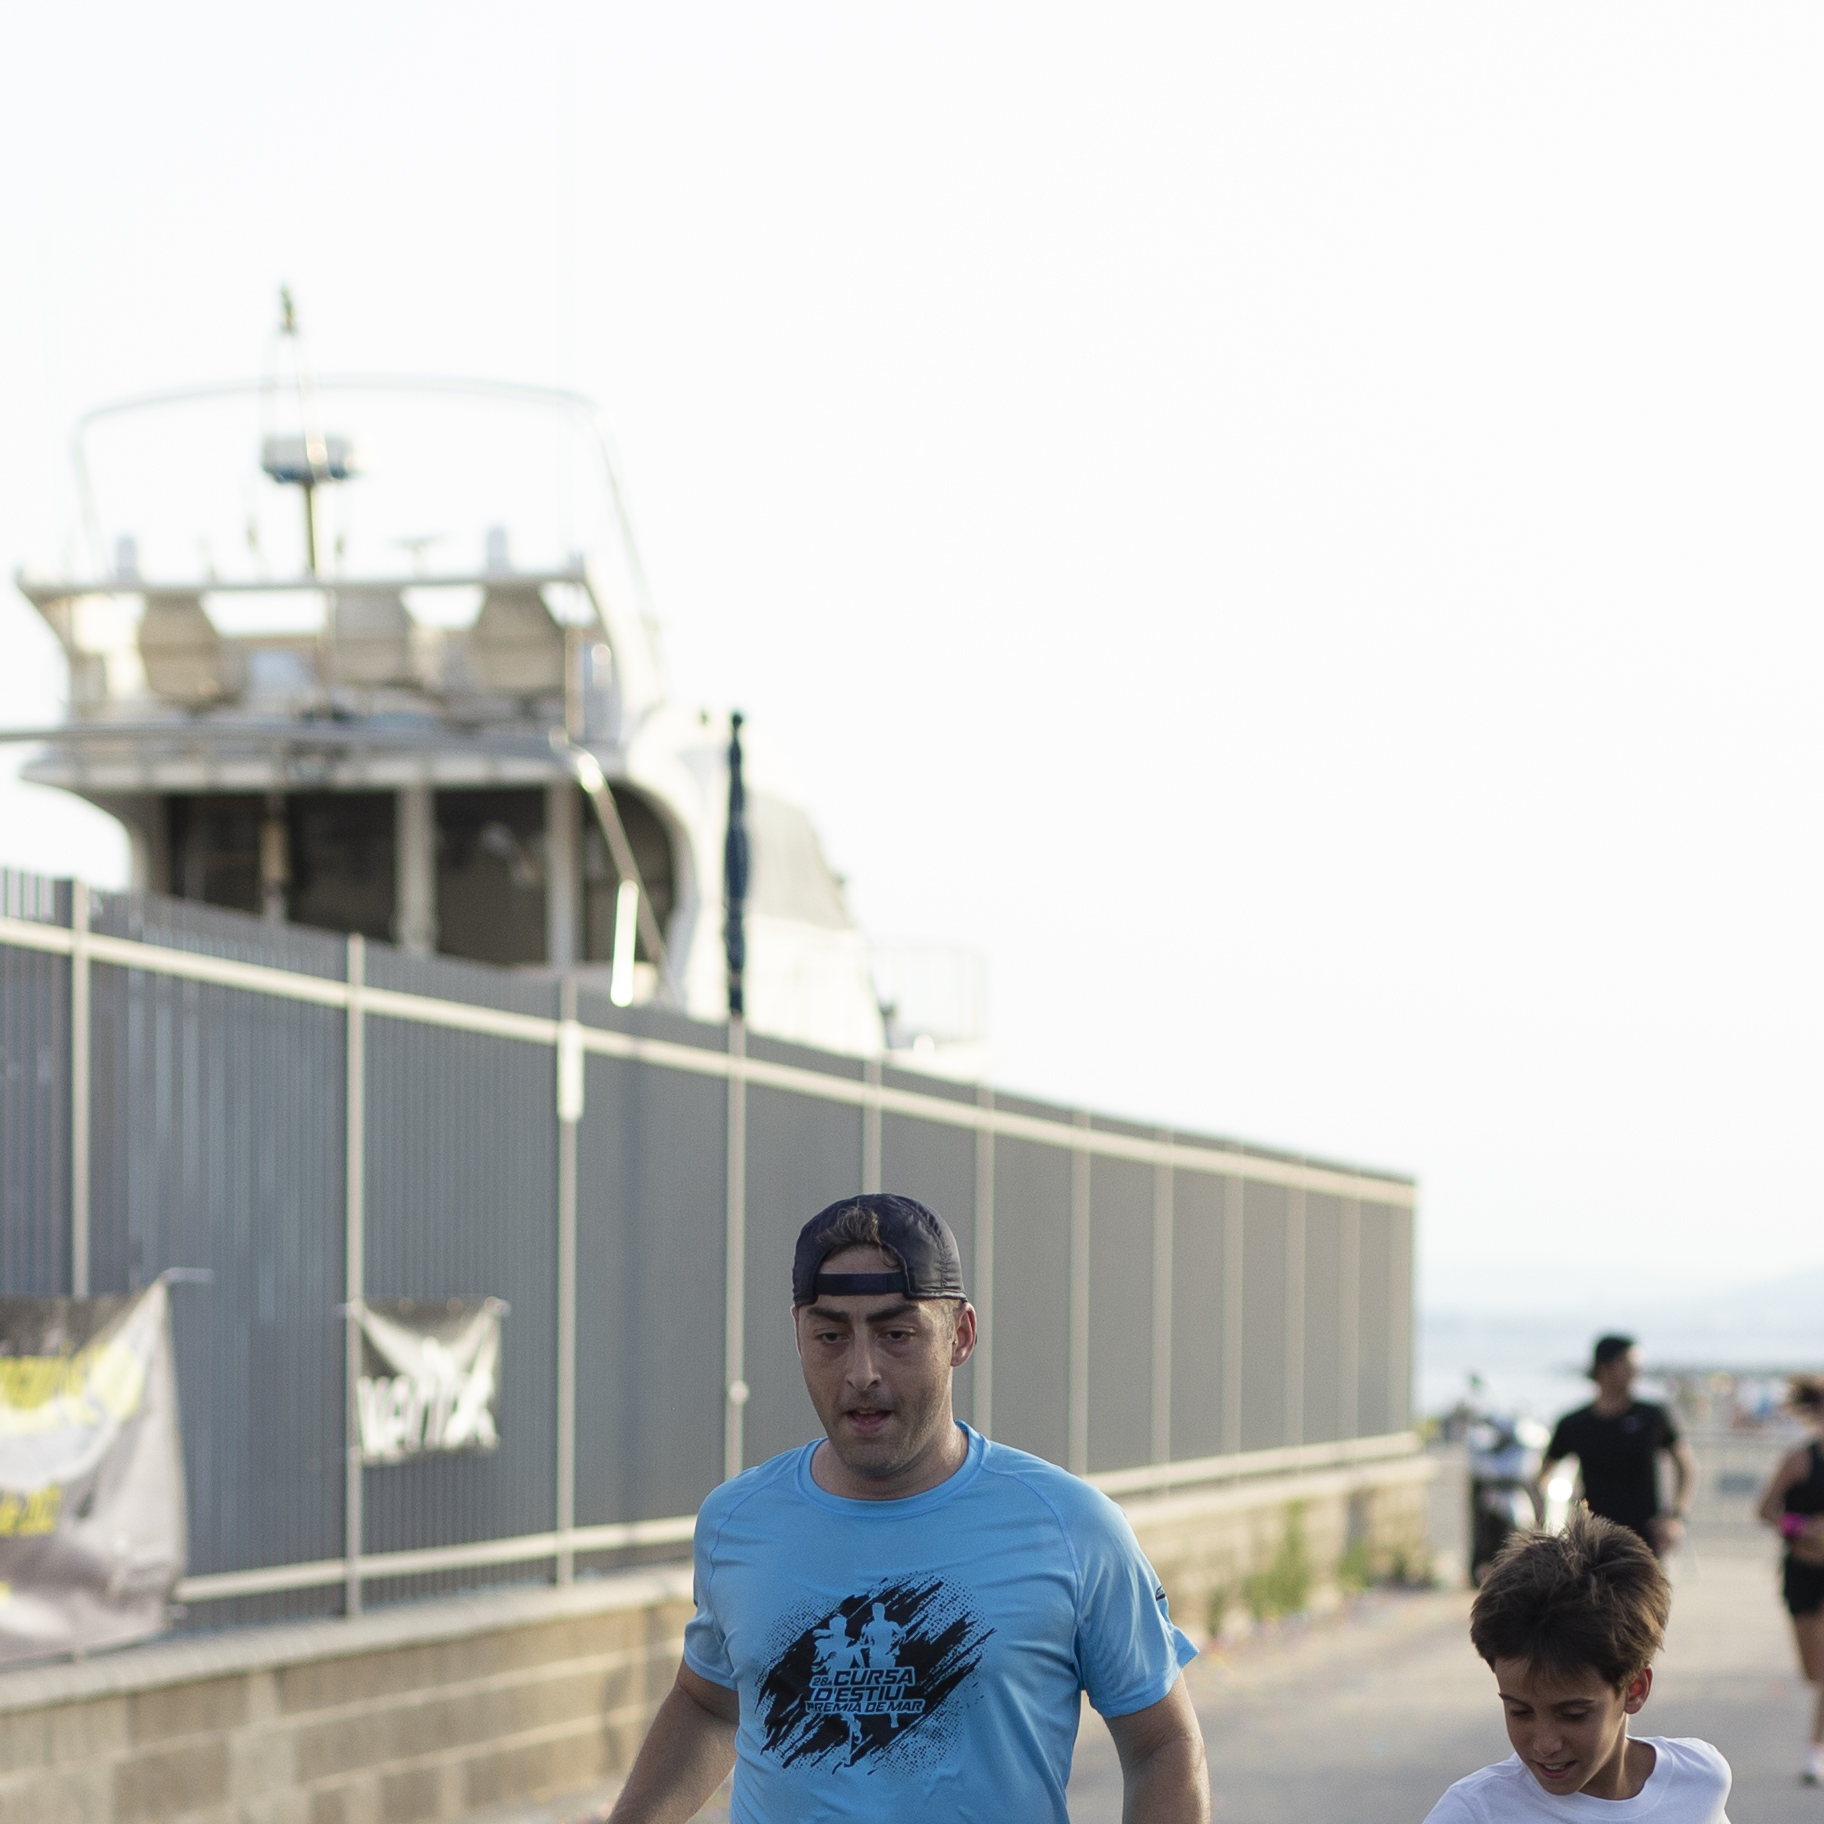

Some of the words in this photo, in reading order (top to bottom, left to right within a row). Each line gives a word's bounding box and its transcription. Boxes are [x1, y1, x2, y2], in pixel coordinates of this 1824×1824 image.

[833, 1668, 915, 1686] CURSA
[813, 1686, 902, 1702] D'ESTIU
[864, 1701, 887, 1712] DE
[886, 1700, 923, 1712] MAR
